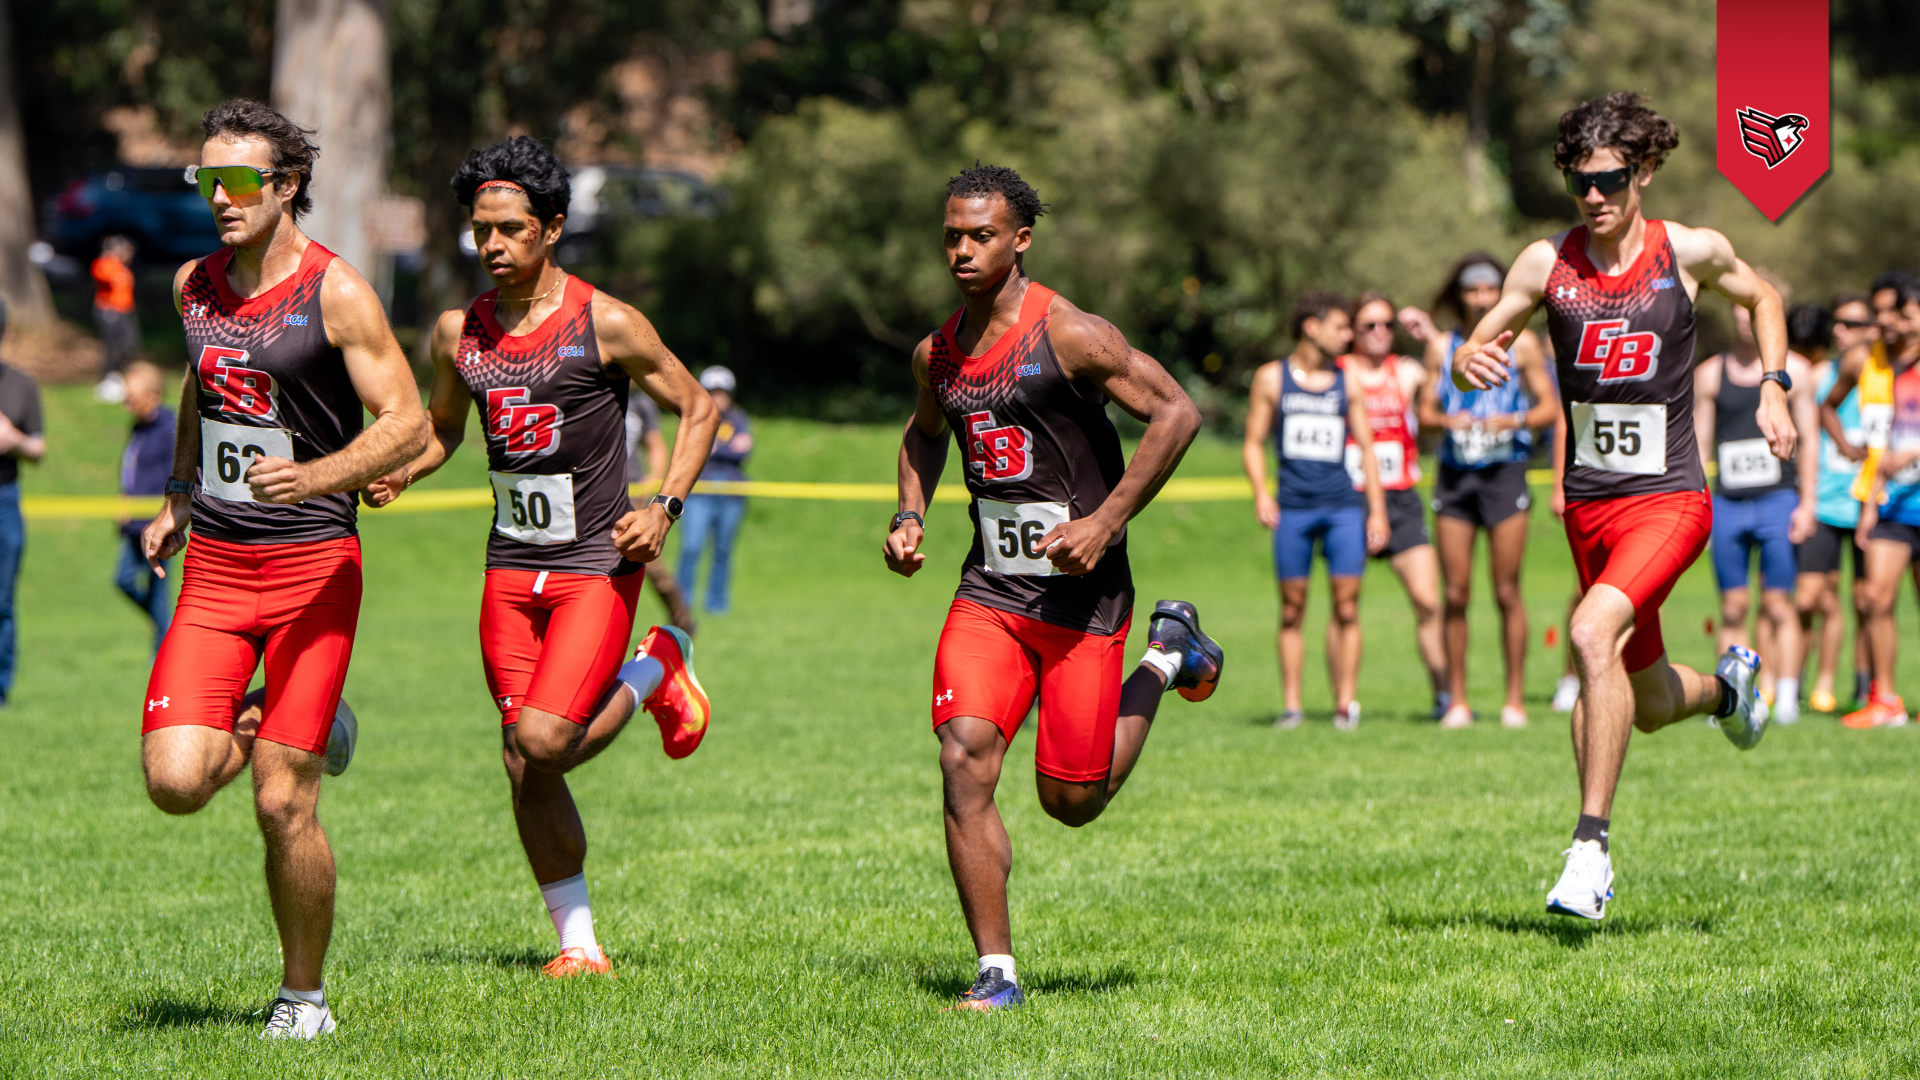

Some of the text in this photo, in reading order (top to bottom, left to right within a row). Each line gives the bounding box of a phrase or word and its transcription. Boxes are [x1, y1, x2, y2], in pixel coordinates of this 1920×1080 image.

[283, 313, 308, 327] CCAA
[557, 345, 585, 357] CCAA
[1016, 363, 1041, 377] CCAA
[1574, 318, 1662, 386] EB
[197, 344, 279, 422] EB
[486, 386, 564, 457] EB
[1593, 420, 1642, 456] 55
[961, 409, 1034, 485] EB
[508, 488, 552, 530] 50
[997, 519, 1047, 560] 56
